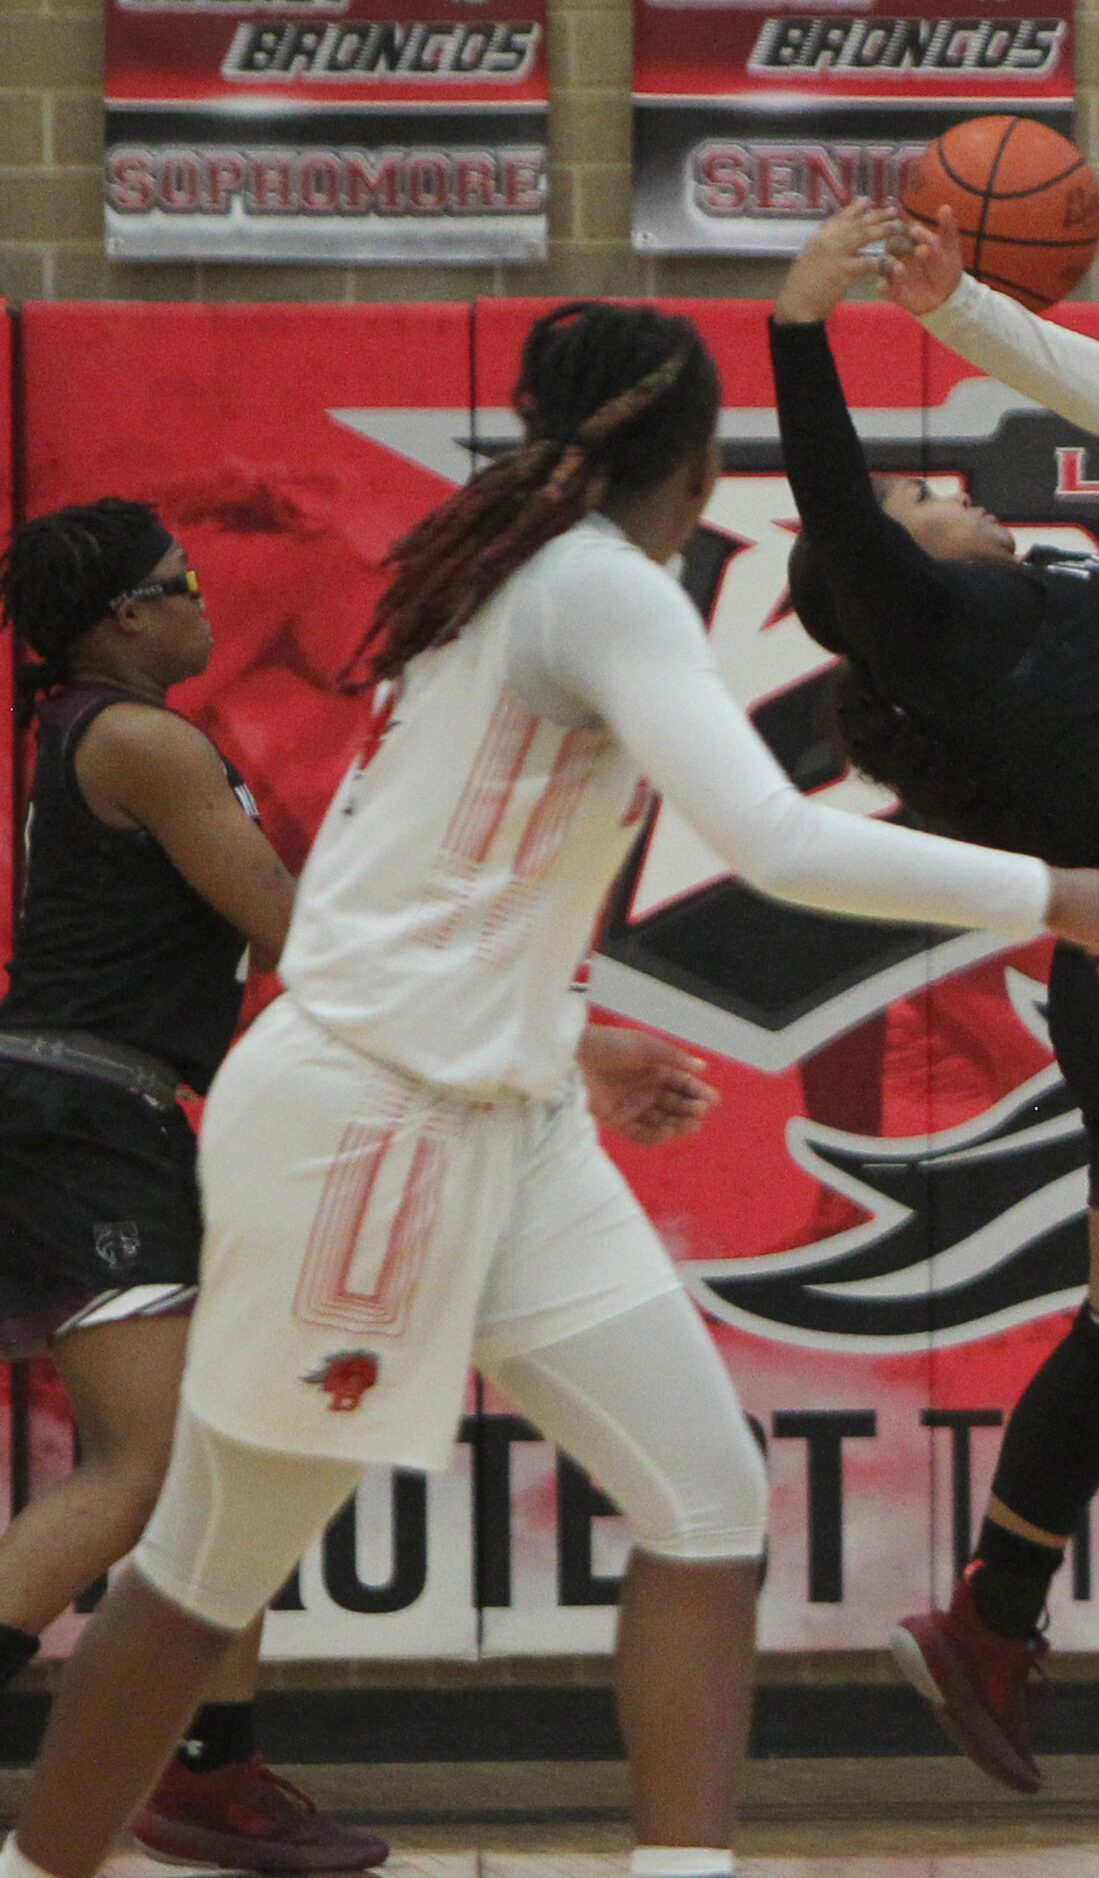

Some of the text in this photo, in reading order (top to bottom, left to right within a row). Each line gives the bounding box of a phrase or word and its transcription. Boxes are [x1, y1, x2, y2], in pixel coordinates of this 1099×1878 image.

[222, 22, 541, 81] BRONCOS
[748, 19, 1068, 76] BRONCOS
[107, 145, 548, 217] SOPHOMORE
[694, 140, 930, 218] SENI
